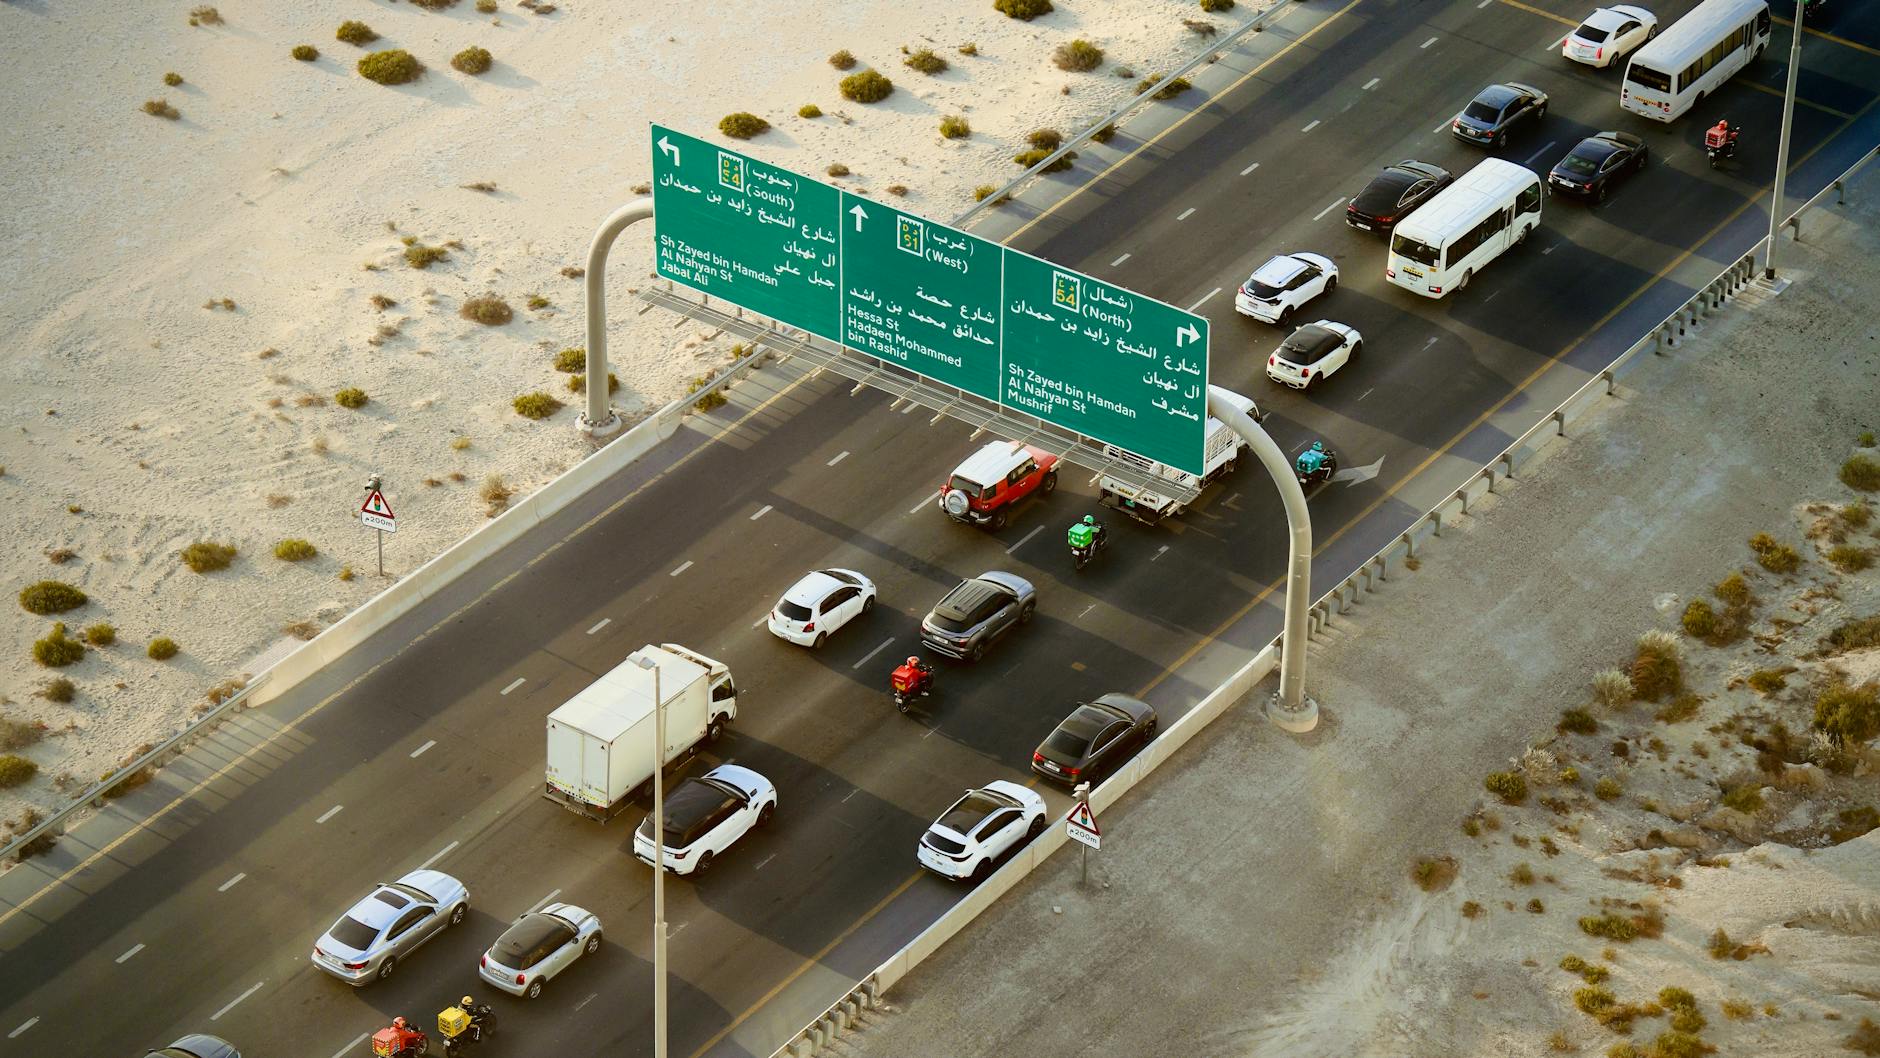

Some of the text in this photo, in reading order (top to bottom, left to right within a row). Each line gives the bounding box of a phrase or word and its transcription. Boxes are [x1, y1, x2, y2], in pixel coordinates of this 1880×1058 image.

[659, 173, 836, 244] شارع الشيخ زايد بن حمدان
[746, 183, 795, 211] (South)
[660, 234, 779, 287] Sh Zayed bin Hamdan
[783, 240, 816, 260] نهيان
[925, 247, 969, 275] (West)
[661, 247, 733, 283] Al Nahyan St
[661, 260, 709, 286] Jabal Ali
[807, 270, 836, 290] جبل
[916, 286, 996, 325] شارع حصة
[1010, 300, 1056, 322] حمدان
[1056, 288, 1076, 307] 54
[847, 303, 900, 332] Hessa St
[849, 287, 995, 345] حدائق محمد بن راشد
[1060, 318, 1078, 334] بن
[1082, 303, 1132, 333] (North)
[847, 316, 962, 368] Hadaeq Mohammed
[847, 329, 908, 361] bin Rashid
[1083, 327, 1110, 346] زايد
[1116, 336, 1157, 360] الشيخ
[1008, 362, 1137, 419] Sh Zayed bin Hamdan
[1142, 371, 1179, 391] نهيان
[1007, 388, 1053, 414] Mushrif
[1008, 376, 1087, 415] Al Nahyan St
[1151, 397, 1199, 421] مشرف
